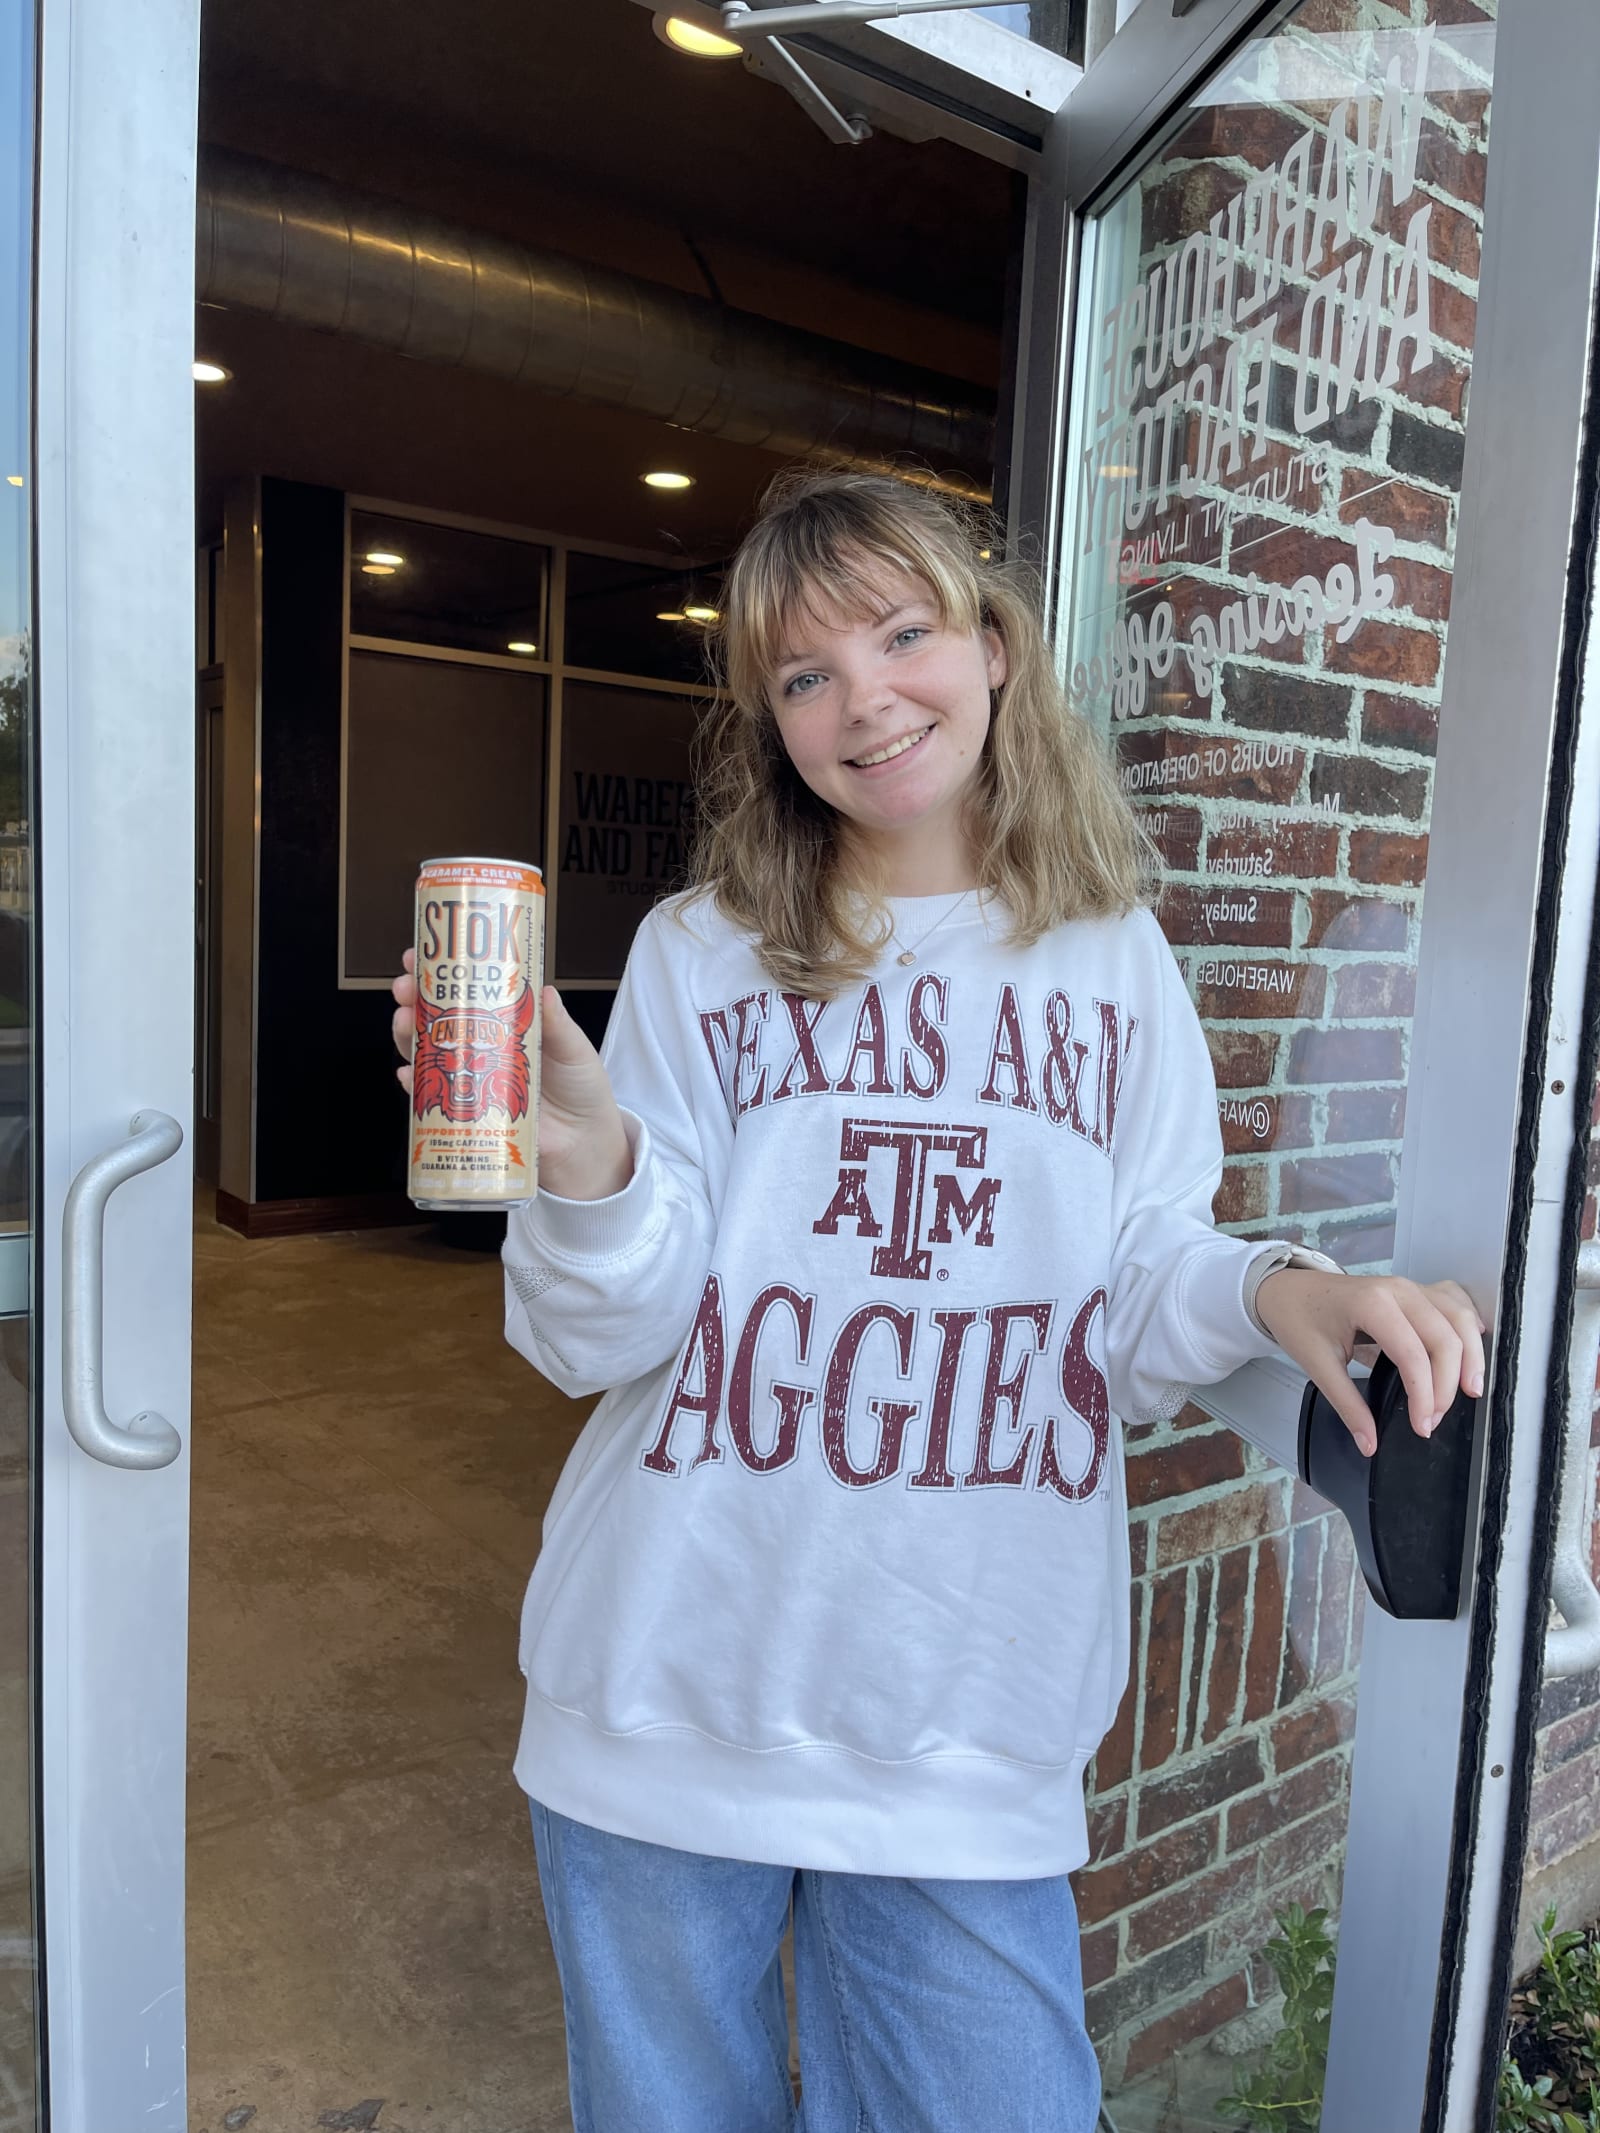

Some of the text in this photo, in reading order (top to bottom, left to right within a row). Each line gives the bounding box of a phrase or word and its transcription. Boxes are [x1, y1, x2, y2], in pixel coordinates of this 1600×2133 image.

[561, 824, 631, 876] AND
[481, 868, 523, 880] CREAM
[436, 964, 501, 982] COLD
[436, 983, 502, 1001] BREW
[435, 1018, 498, 1042] ENERGY
[698, 971, 951, 1130] TEXAS
[416, 1127, 472, 1137] SUPPORTS
[455, 1139, 499, 1147] CAFFEINE
[421, 1163, 457, 1171] GUARANA
[470, 1163, 510, 1171] GINSENG
[445, 1155, 490, 1163] VITAMINS
[639, 1271, 1110, 1504] AGGIES
